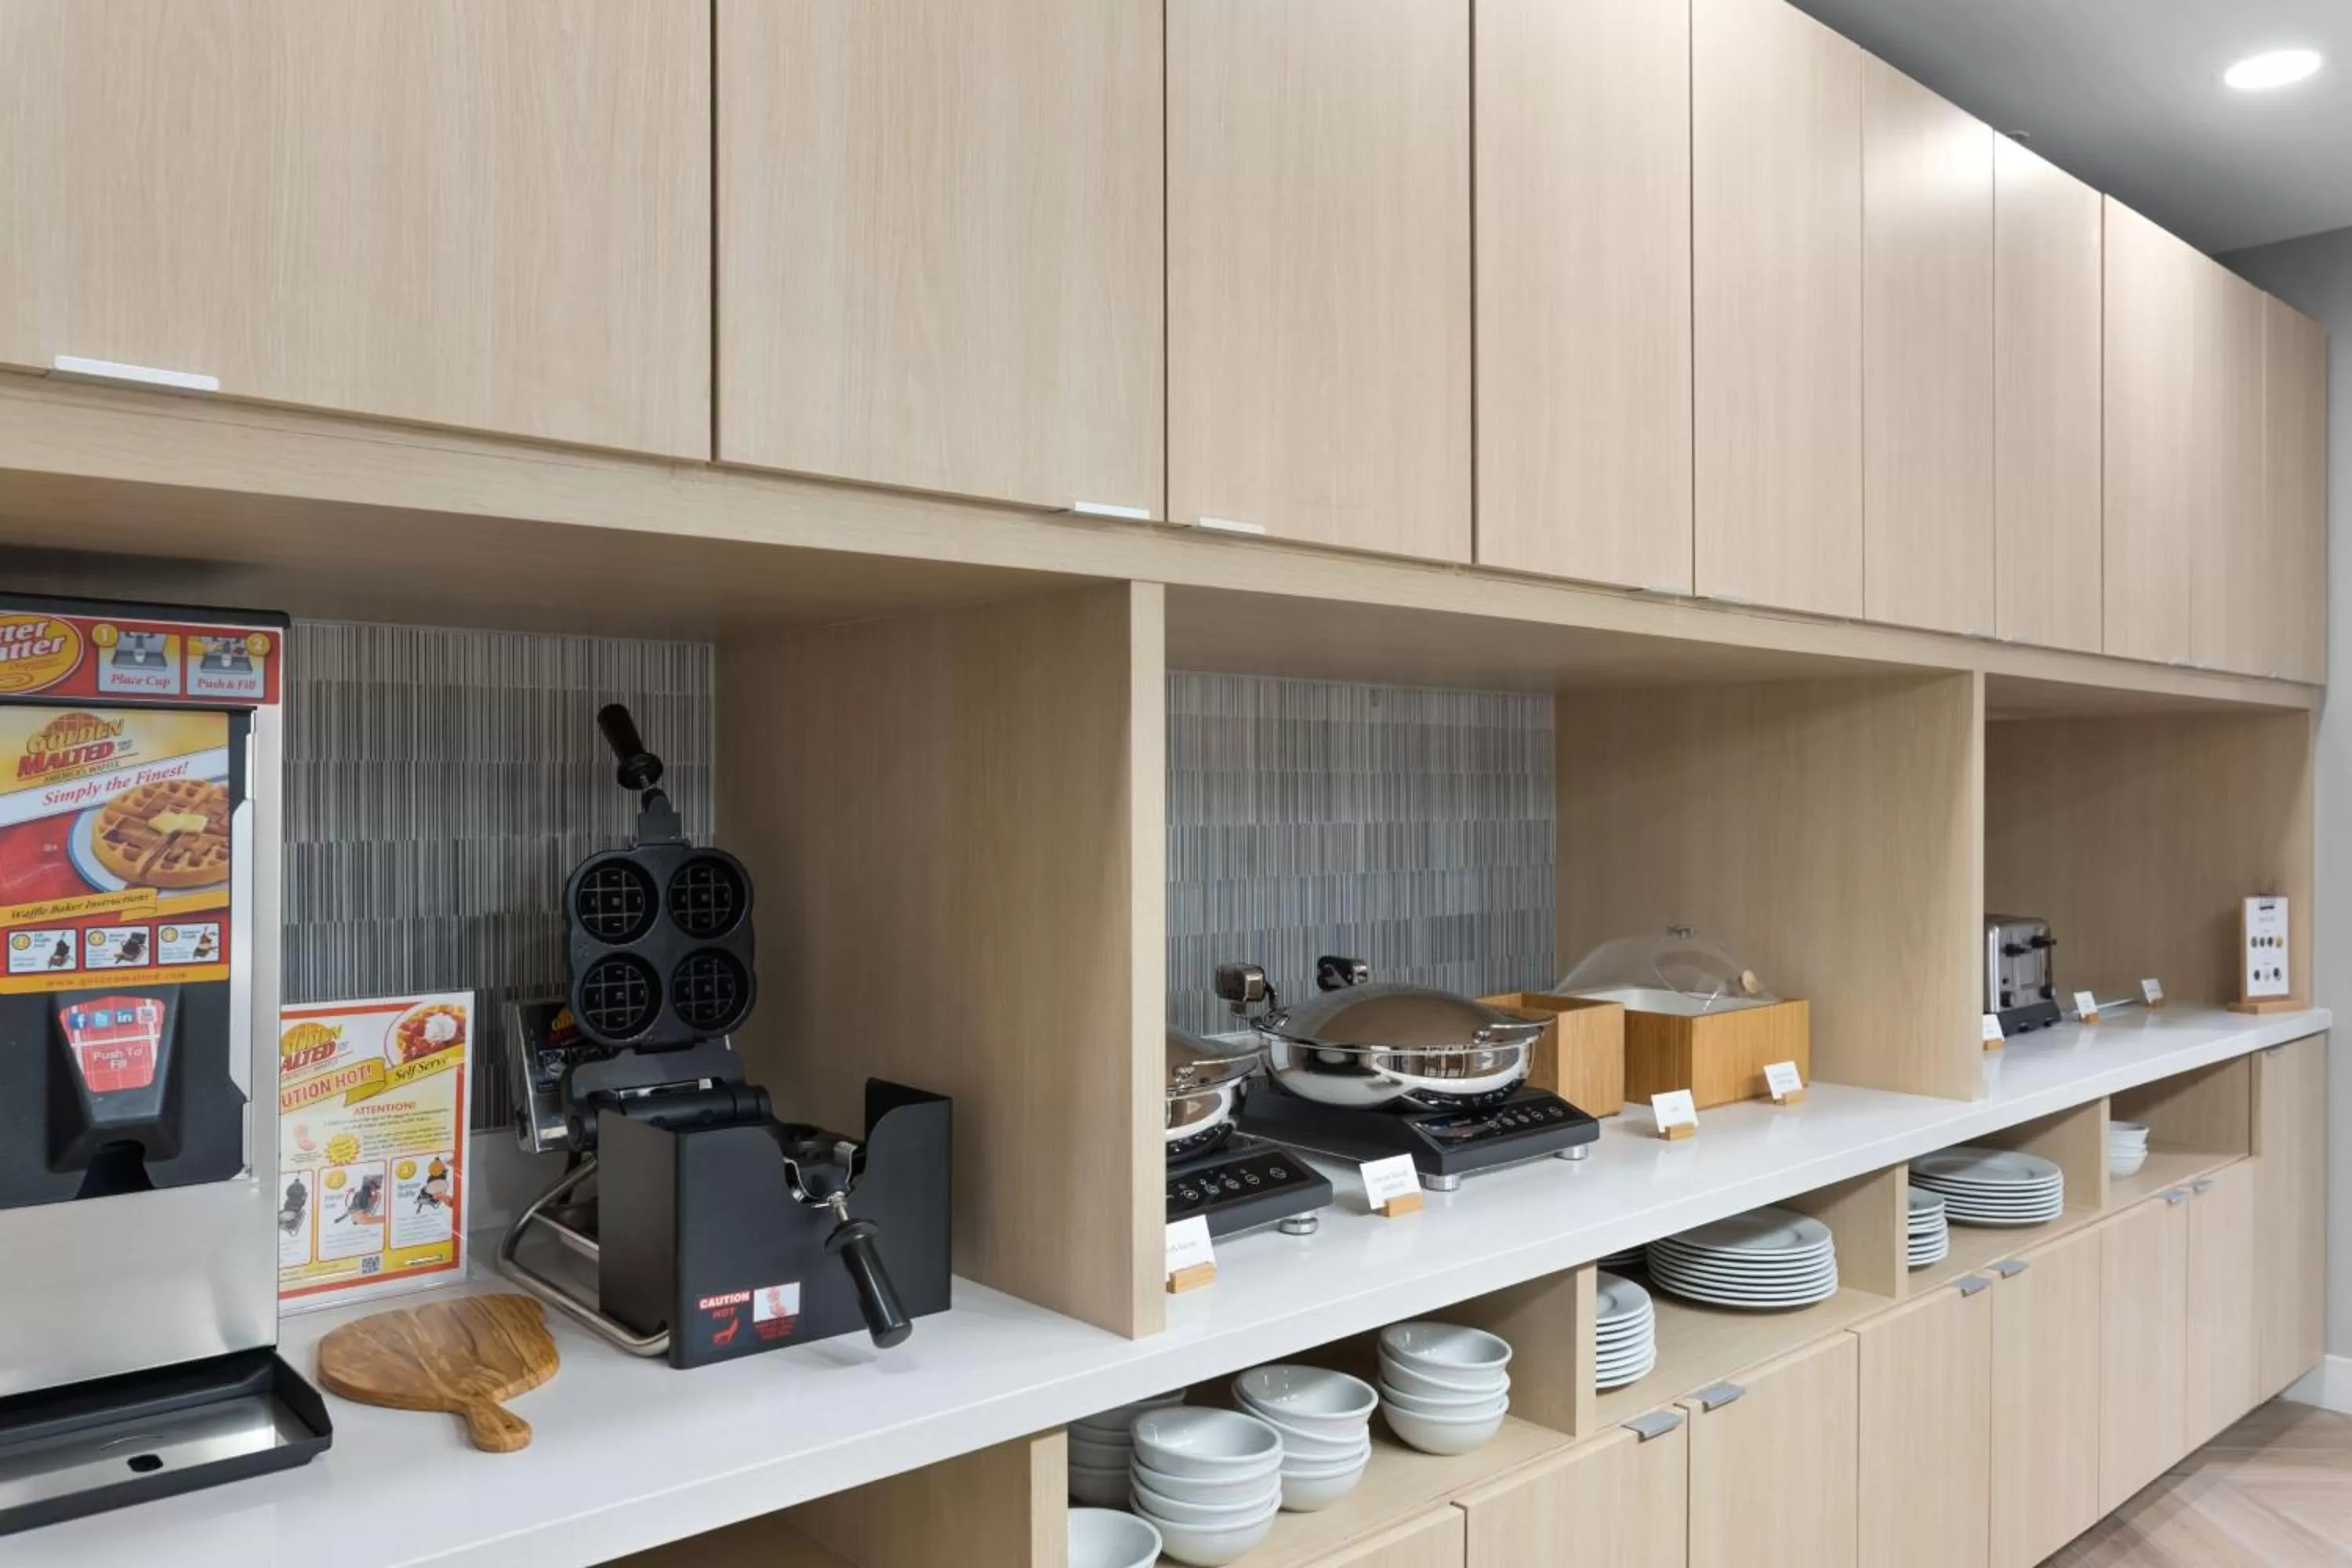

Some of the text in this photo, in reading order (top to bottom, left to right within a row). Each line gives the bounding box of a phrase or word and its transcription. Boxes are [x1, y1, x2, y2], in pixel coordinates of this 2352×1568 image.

[111, 673, 171, 688] Place Cup
[198, 677, 224, 690] Push
[238, 679, 258, 691] Fill
[26, 717, 125, 754] GOLDEN
[16, 740, 116, 779] MALTED
[42, 760, 190, 807] Simply the Finest!
[12, 893, 151, 920] Waffle Baker Instructions
[93, 1049, 123, 1061] Push
[335, 1063, 372, 1088] HOT!
[394, 1065, 416, 1081] Self
[354, 1101, 417, 1116] ATTENTION!
[699, 1291, 750, 1310] CAUTION
